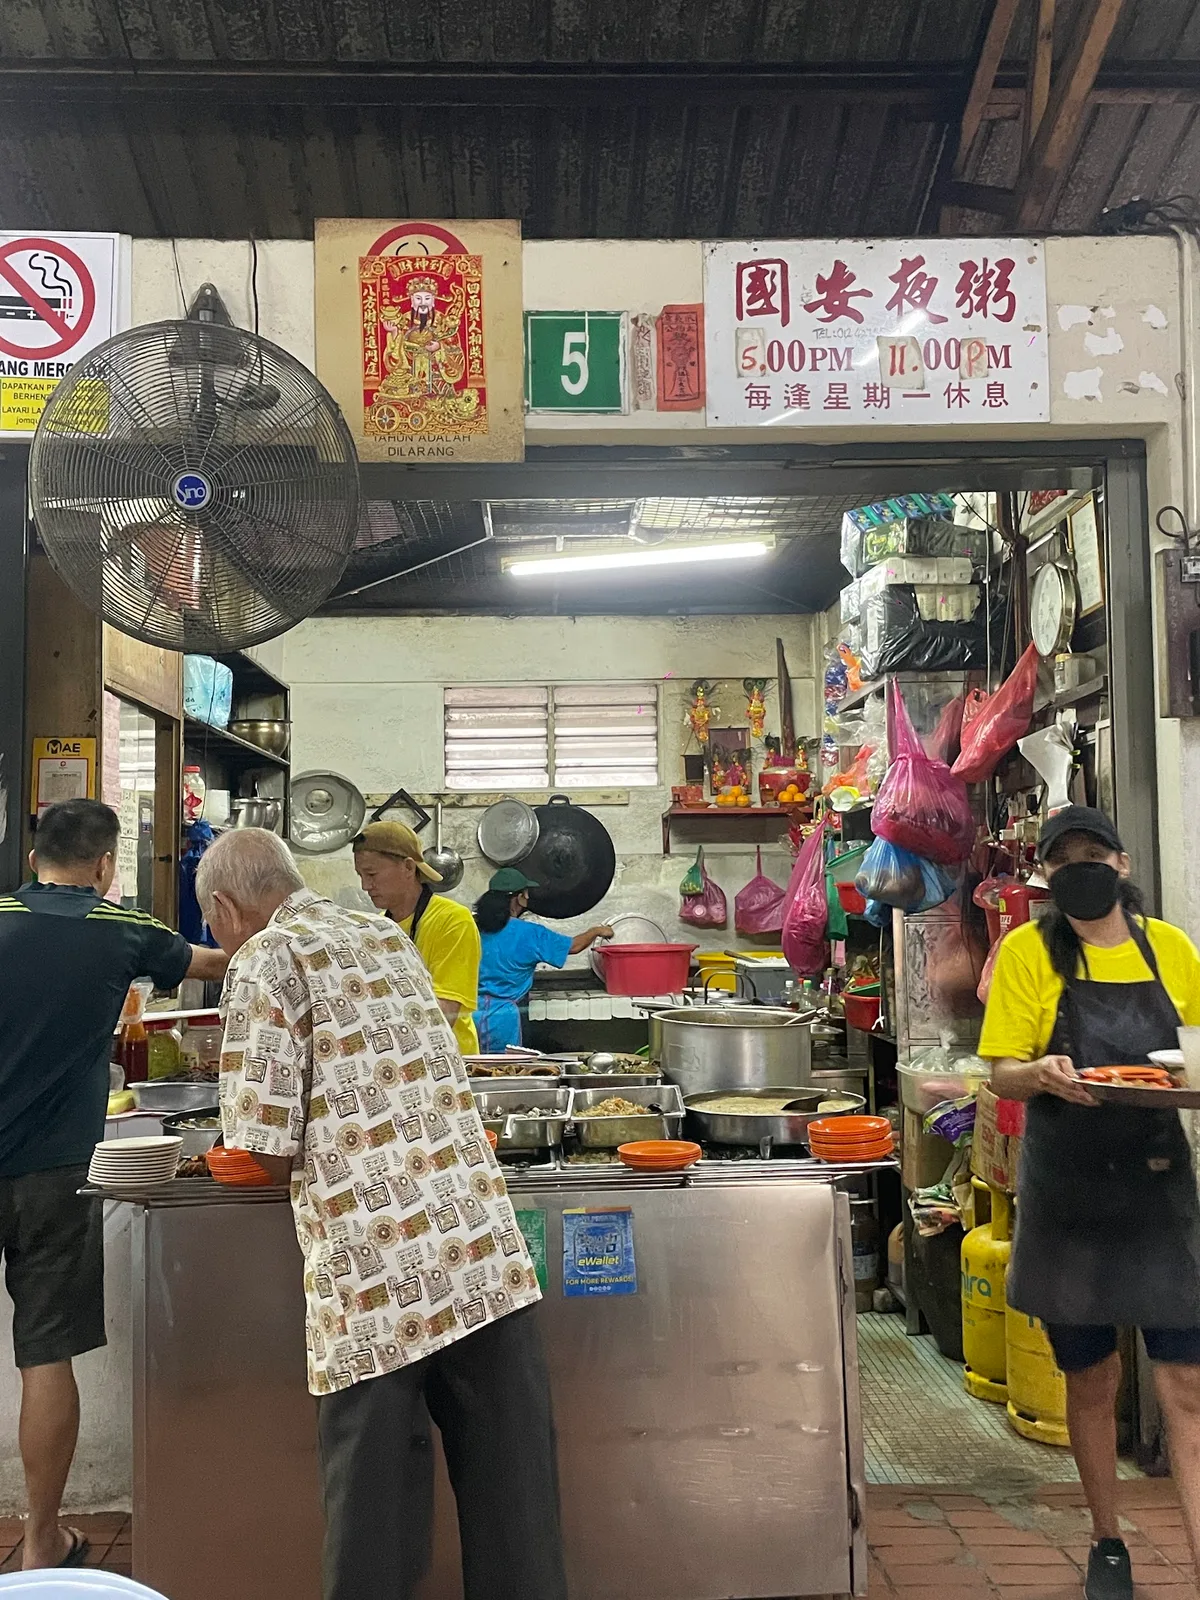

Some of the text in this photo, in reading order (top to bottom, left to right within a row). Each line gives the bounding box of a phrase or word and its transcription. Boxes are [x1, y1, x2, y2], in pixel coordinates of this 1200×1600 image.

[397, 257, 445, 274] 財神到
[735, 254, 1017, 328] 國安夜粥
[560, 331, 590, 396] 5
[2, 382, 44, 391] DAPATKAN
[744, 380, 1009, 411] 每逢星期一休息
[2, 406, 30, 414] LAYARI
[387, 446, 455, 457] DILARANG
[47, 739, 81, 755] MAE
[577, 1254, 620, 1267] eWallet
[581, 1277, 599, 1285] MORE
